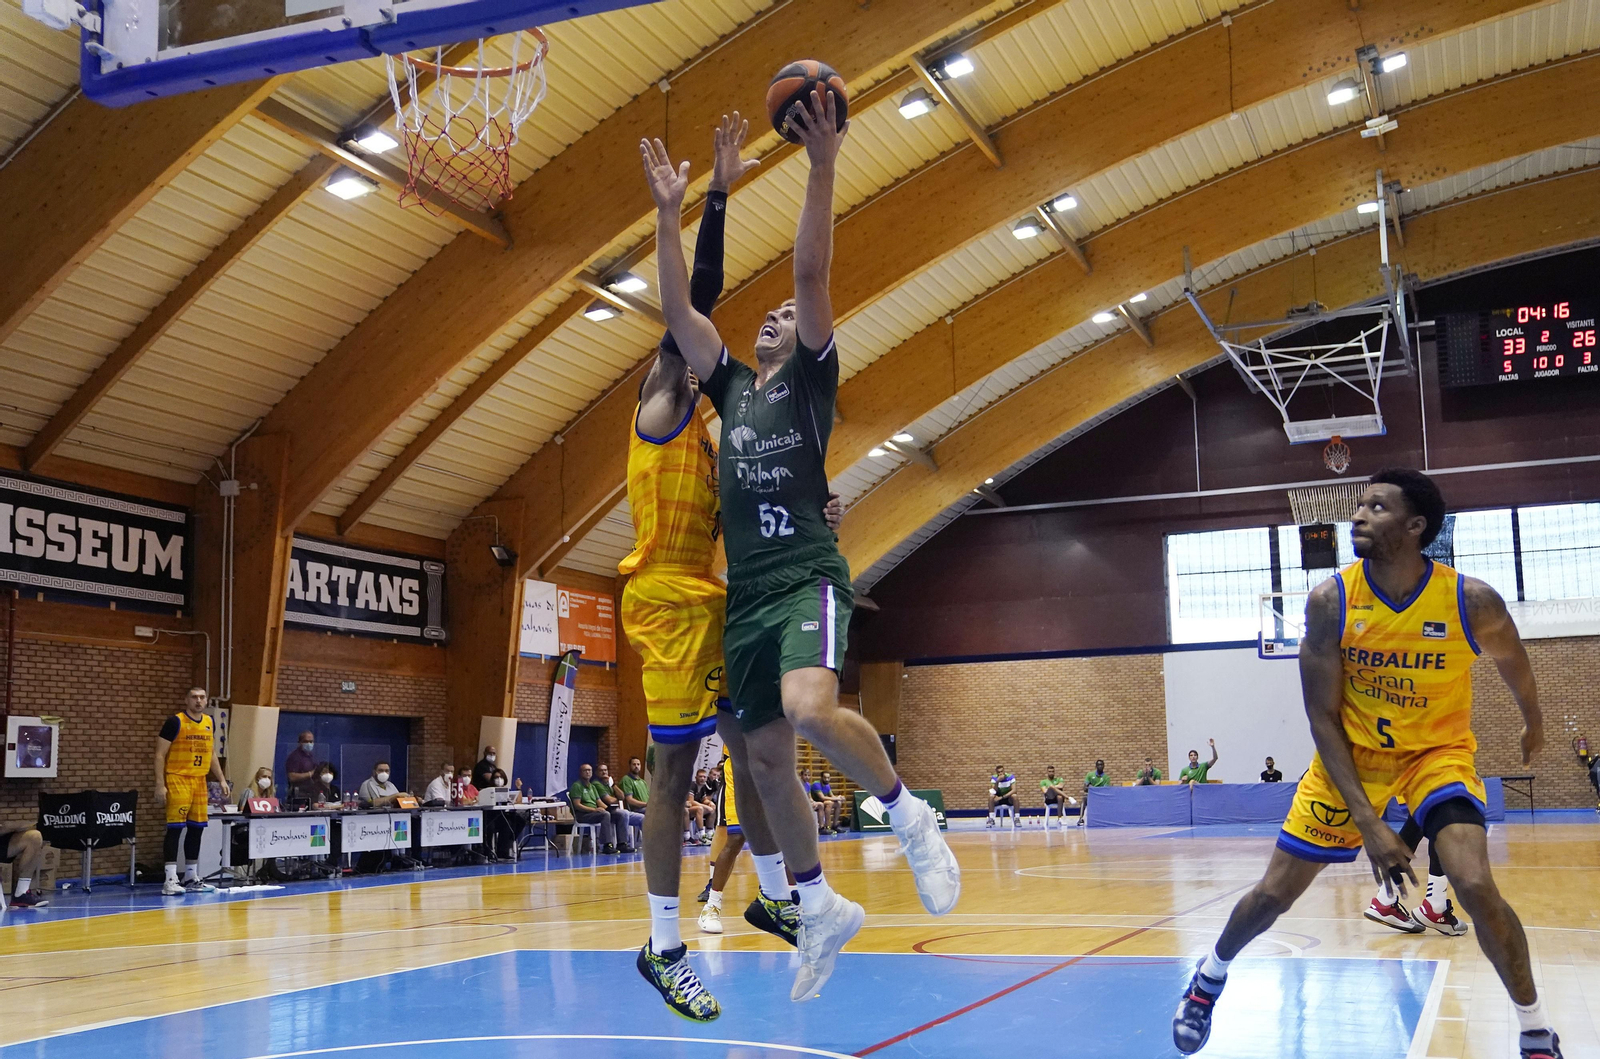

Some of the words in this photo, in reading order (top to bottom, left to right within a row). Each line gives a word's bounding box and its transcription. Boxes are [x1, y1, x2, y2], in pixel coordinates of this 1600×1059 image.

[1518, 302, 1569, 323] 04:16
[1566, 319, 1595, 329] VISITANTE
[1496, 327, 1524, 337] LOCAL
[1541, 330, 1549, 343] 2
[1573, 330, 1596, 348] 26
[1504, 338, 1525, 355] 33
[1536, 344, 1557, 352] PERIODO
[1583, 352, 1591, 364] 3
[1504, 360, 1512, 373] 5
[1534, 369, 1559, 378] JUGADOR
[1577, 364, 1598, 373] FALTAS
[1499, 373, 1519, 382] FALTAS
[755, 428, 802, 452] Unicaja
[758, 502, 795, 538] 52
[1357, 668, 1414, 692] Gran
[1350, 675, 1428, 708] Canaria
[1377, 717, 1395, 748] 5
[193, 755, 203, 767] 23
[43, 812, 87, 826] SPALDING
[96, 811, 133, 824] SPALDING
[1304, 824, 1345, 844] TOYOTA
